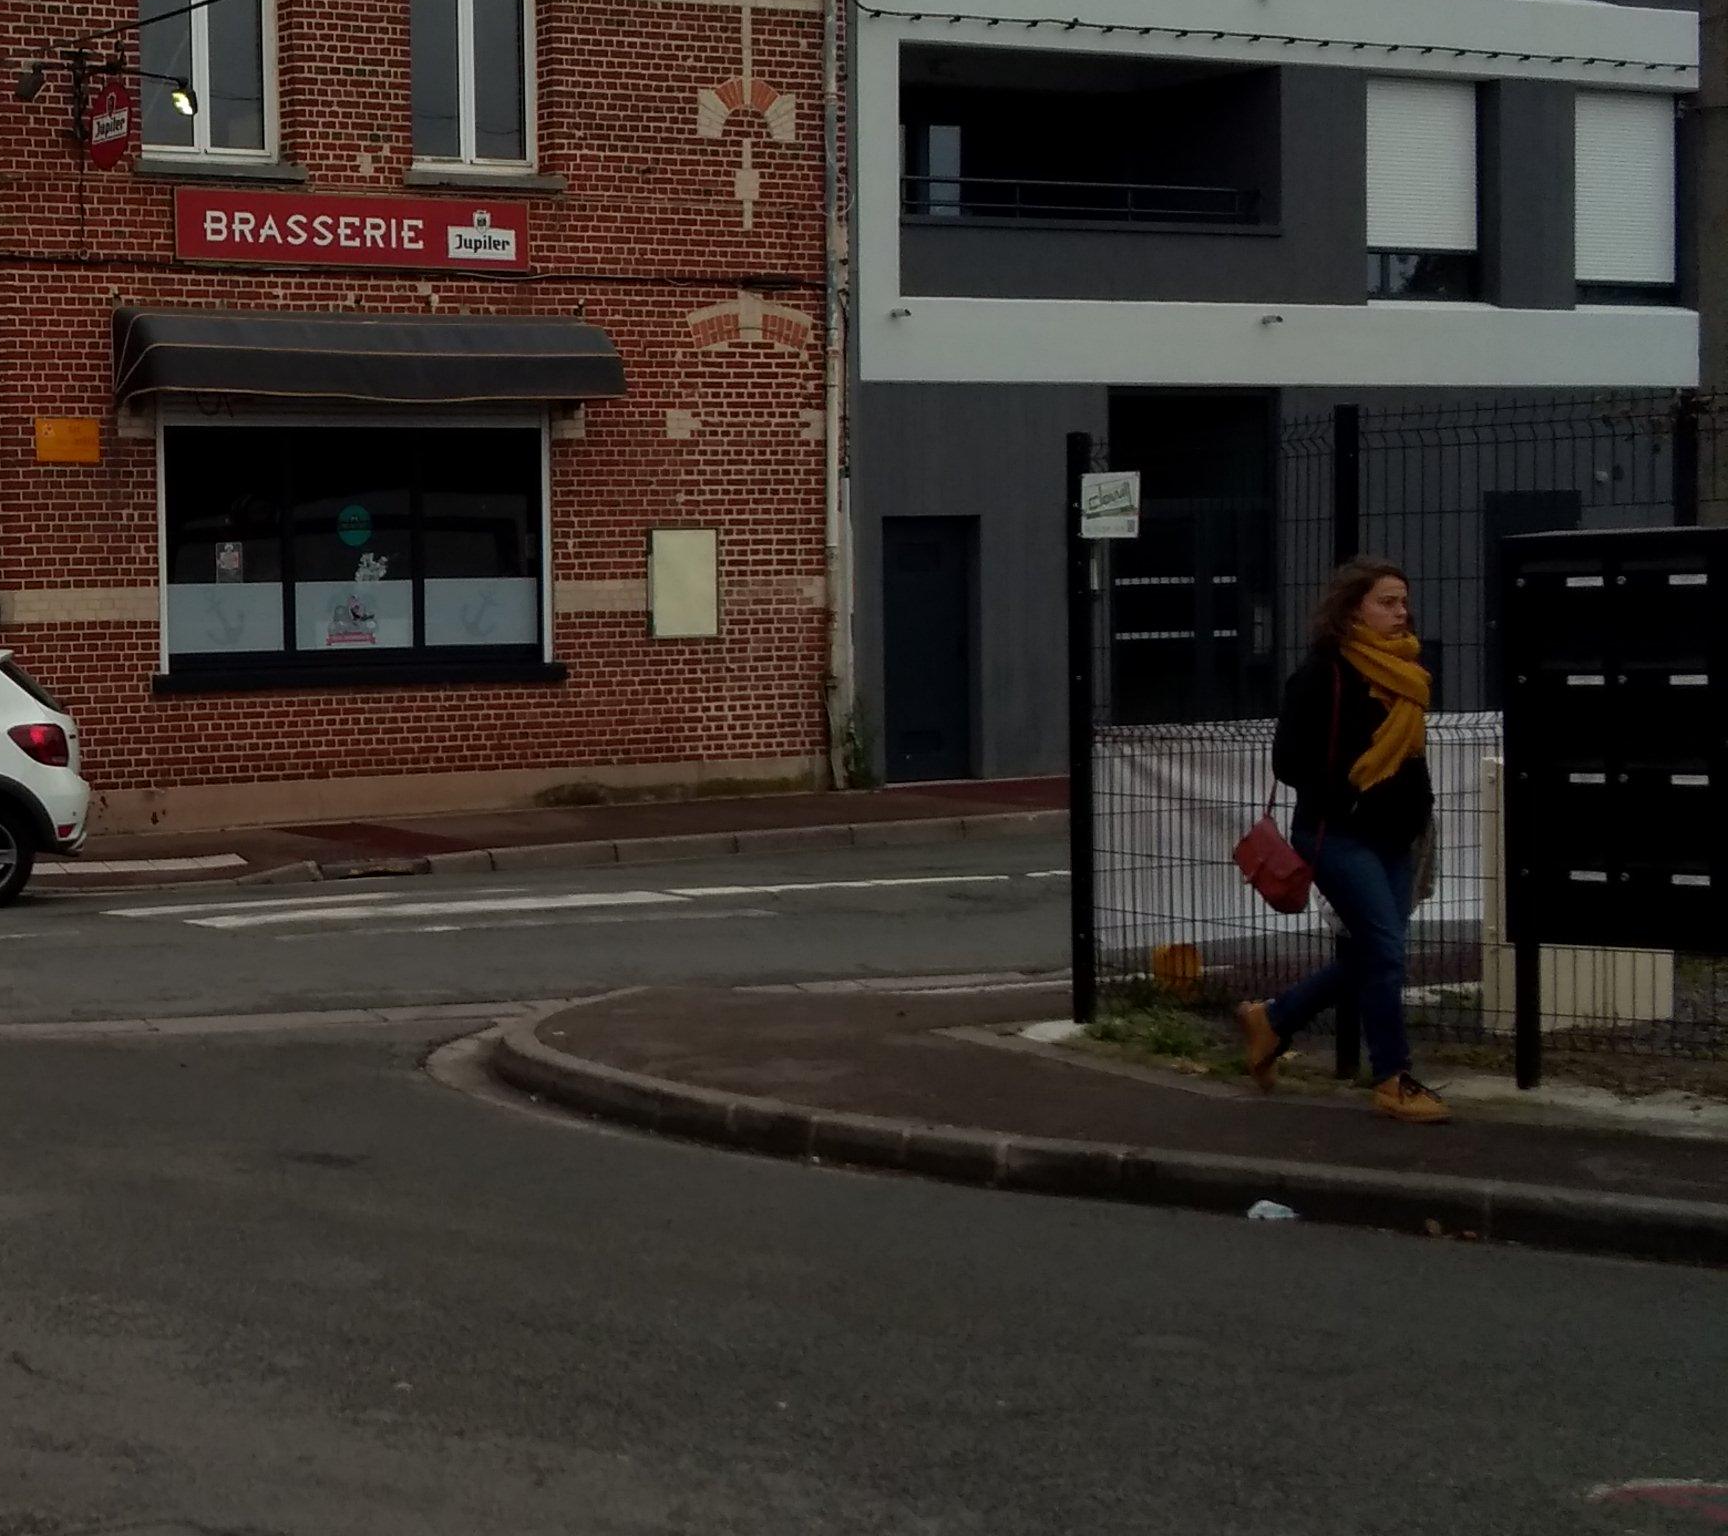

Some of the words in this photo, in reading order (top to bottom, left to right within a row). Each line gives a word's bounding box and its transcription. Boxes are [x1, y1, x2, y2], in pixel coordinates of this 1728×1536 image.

[95, 116, 125, 139] Jupiler
[203, 209, 424, 250] BRASSERIE
[455, 233, 511, 253] Jupiler
